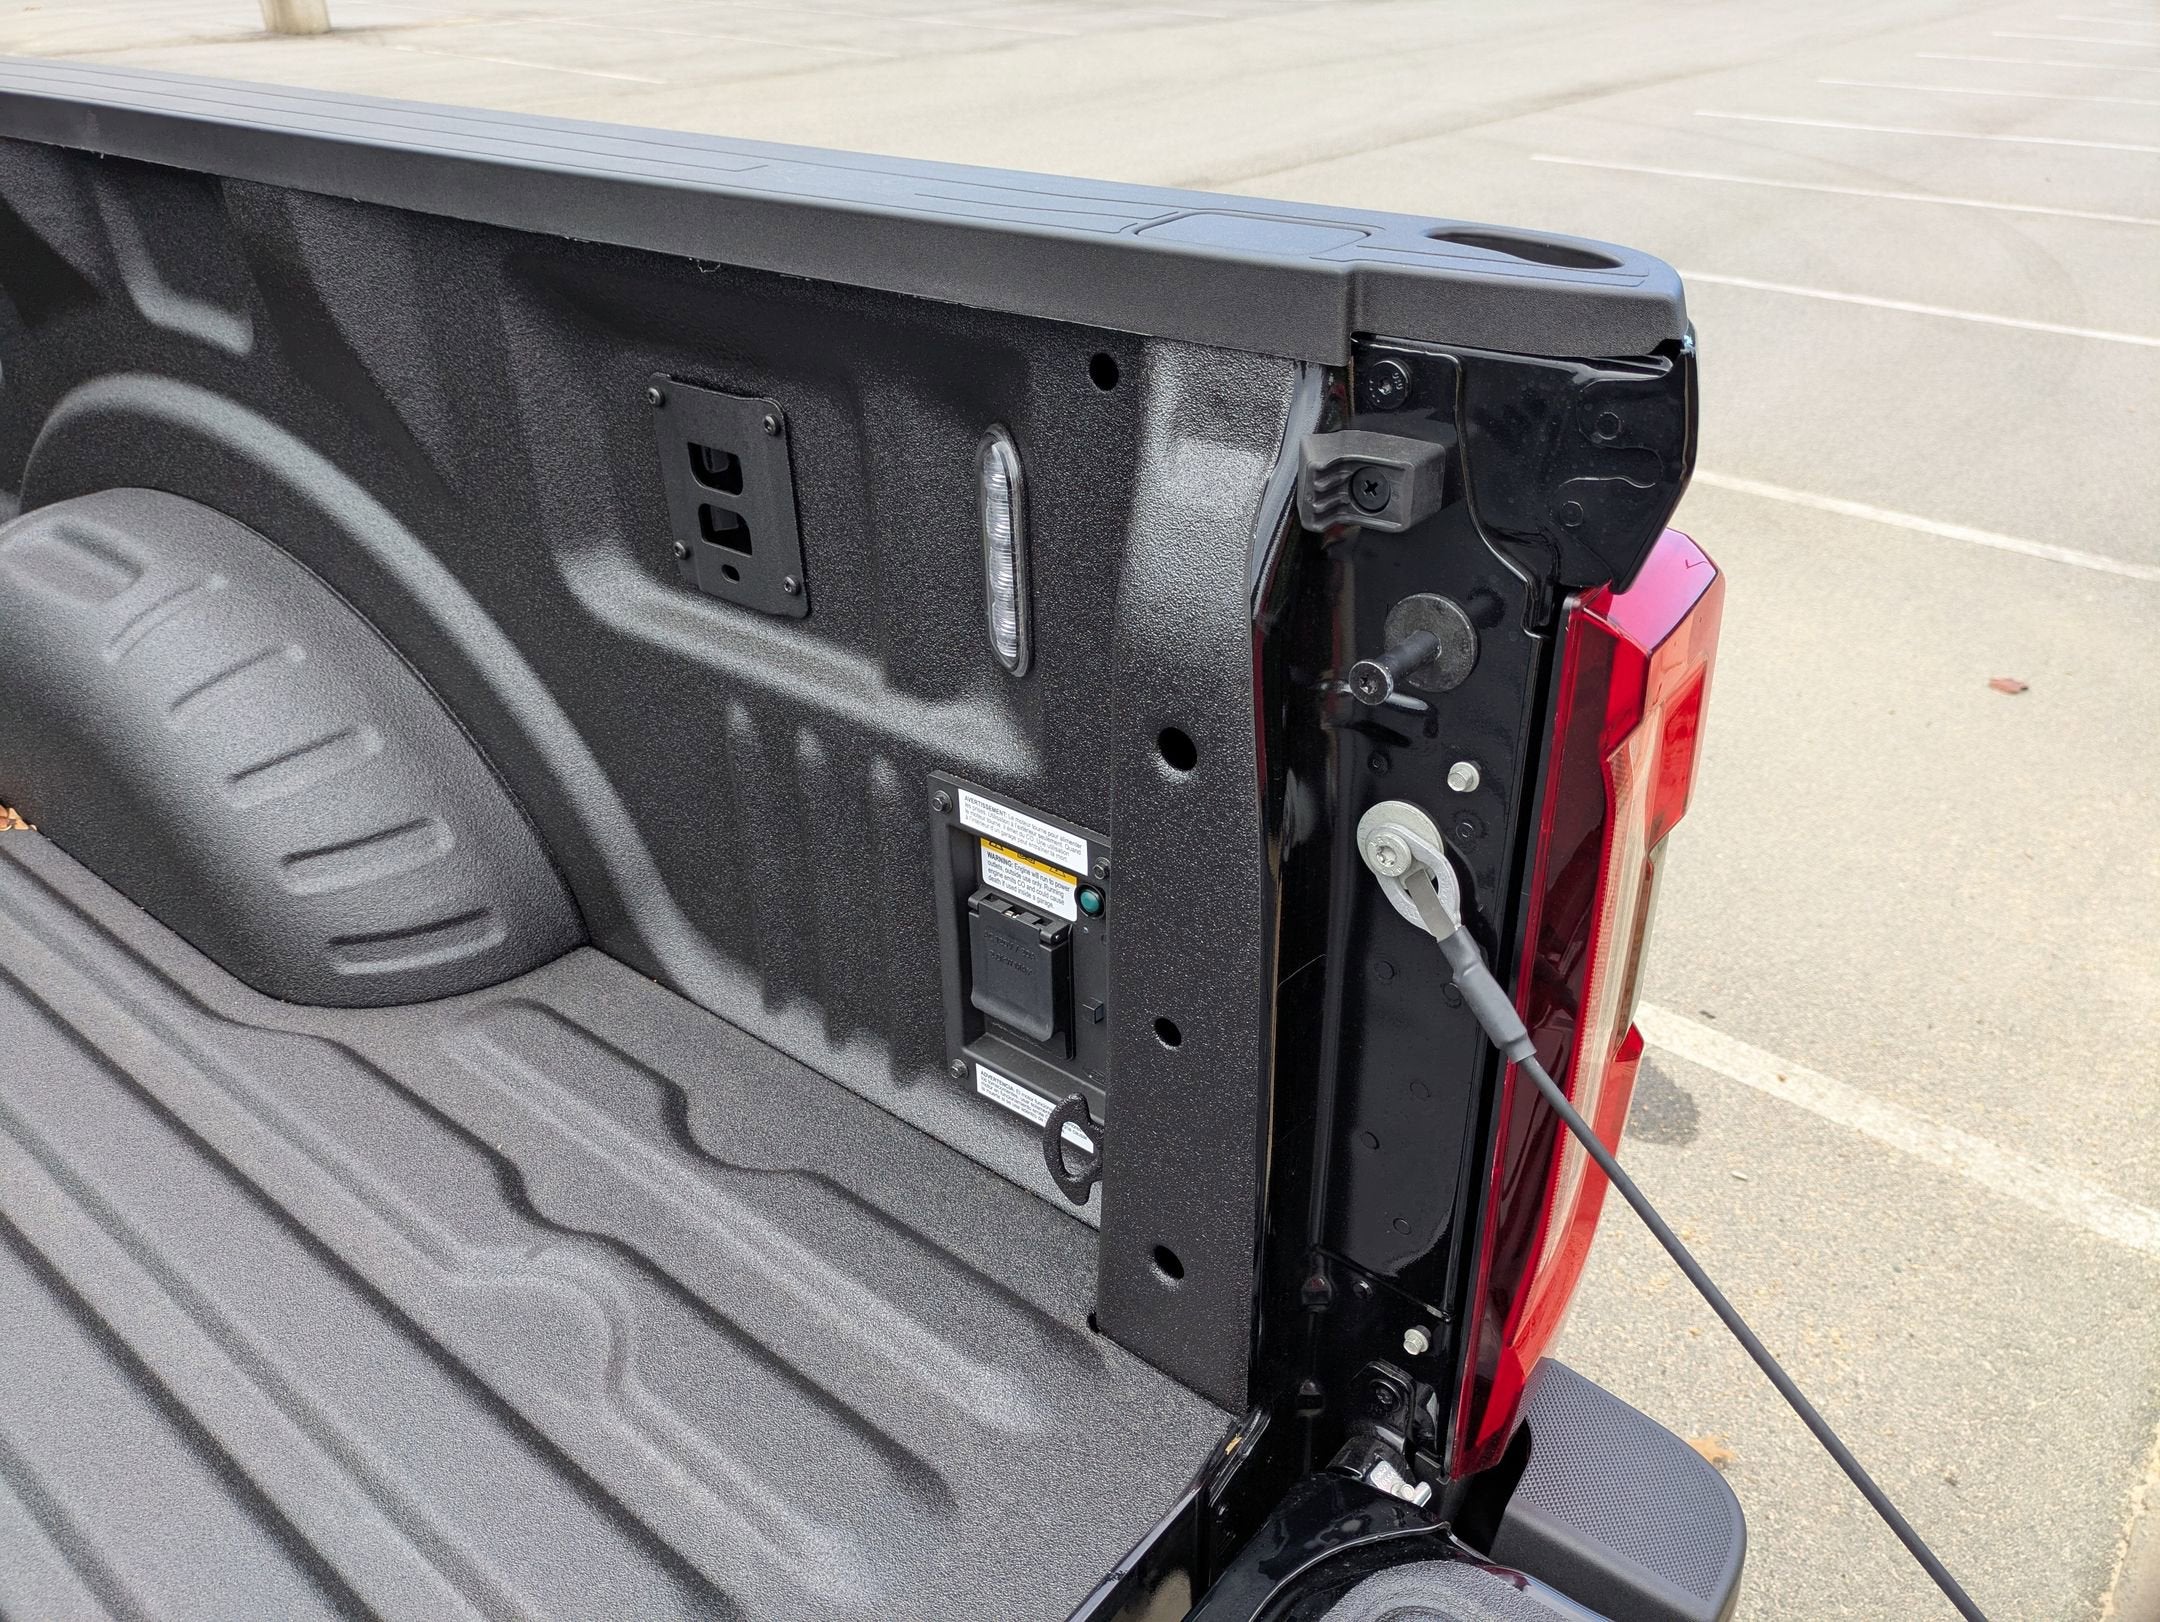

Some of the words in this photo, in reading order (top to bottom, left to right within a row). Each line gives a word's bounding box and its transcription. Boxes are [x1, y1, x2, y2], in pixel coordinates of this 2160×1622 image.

[987, 851, 1013, 868] WARNING:
[1014, 862, 1030, 876] Engine
[1055, 881, 1070, 894] power
